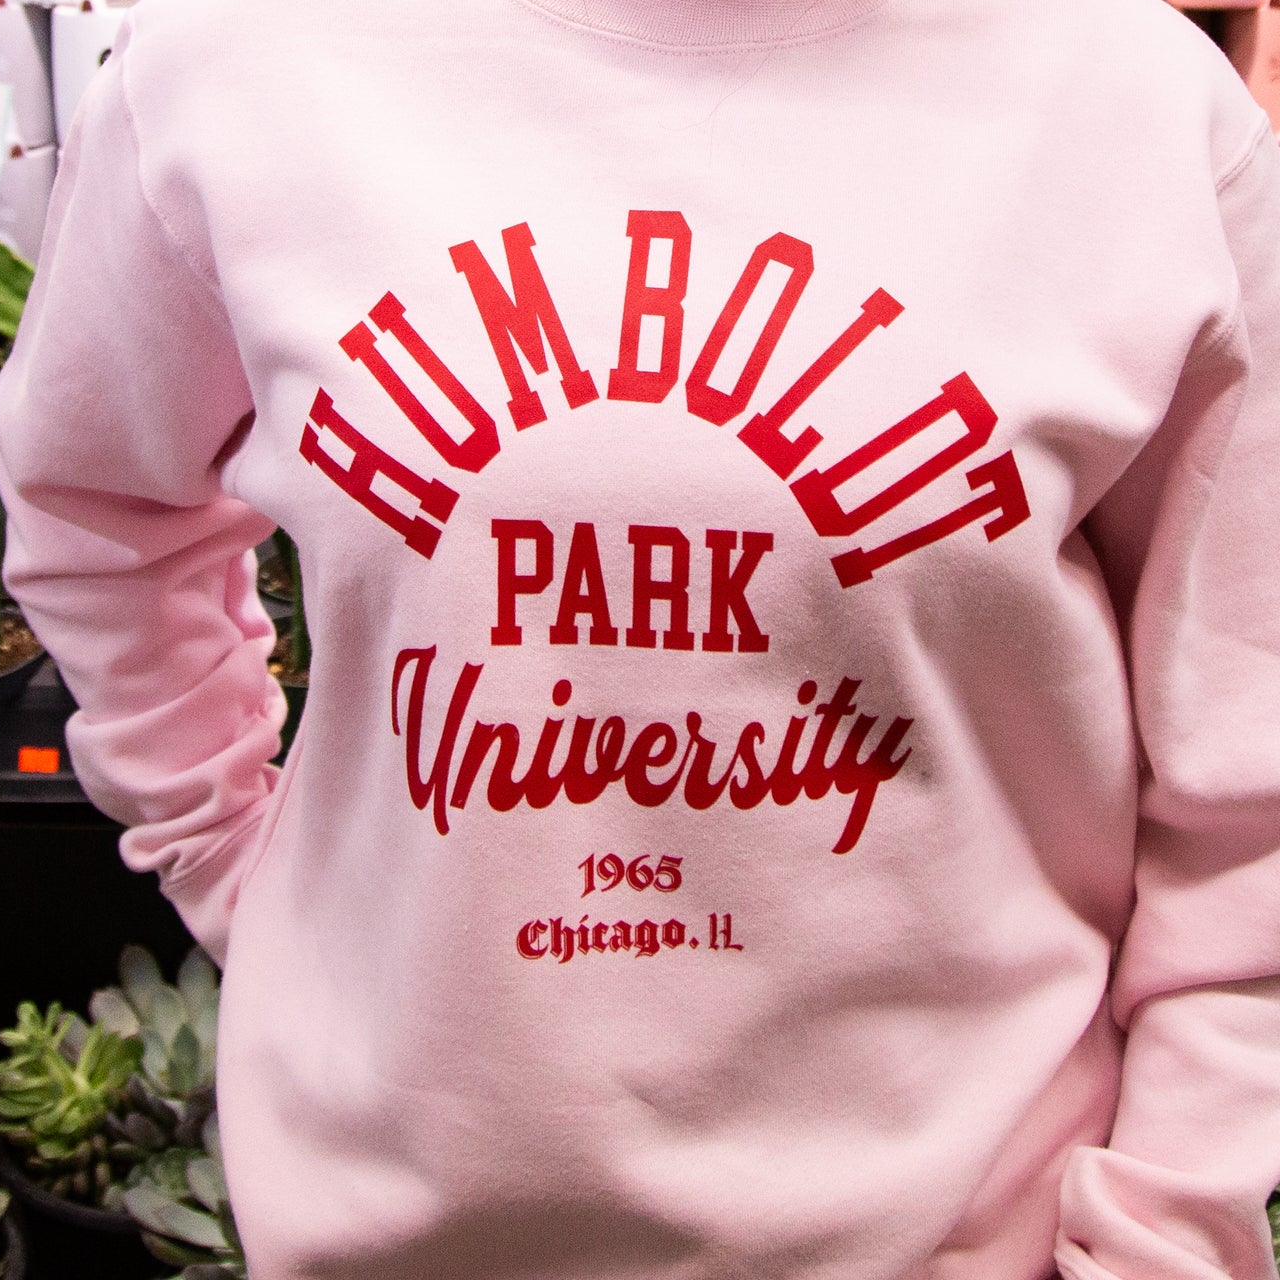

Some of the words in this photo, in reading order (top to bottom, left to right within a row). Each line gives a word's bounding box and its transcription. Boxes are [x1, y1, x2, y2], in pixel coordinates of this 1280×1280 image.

[299, 210, 1031, 589] HUMBOLDT
[491, 519, 775, 653] PARK
[392, 644, 915, 855] University
[578, 852, 683, 898] 1965
